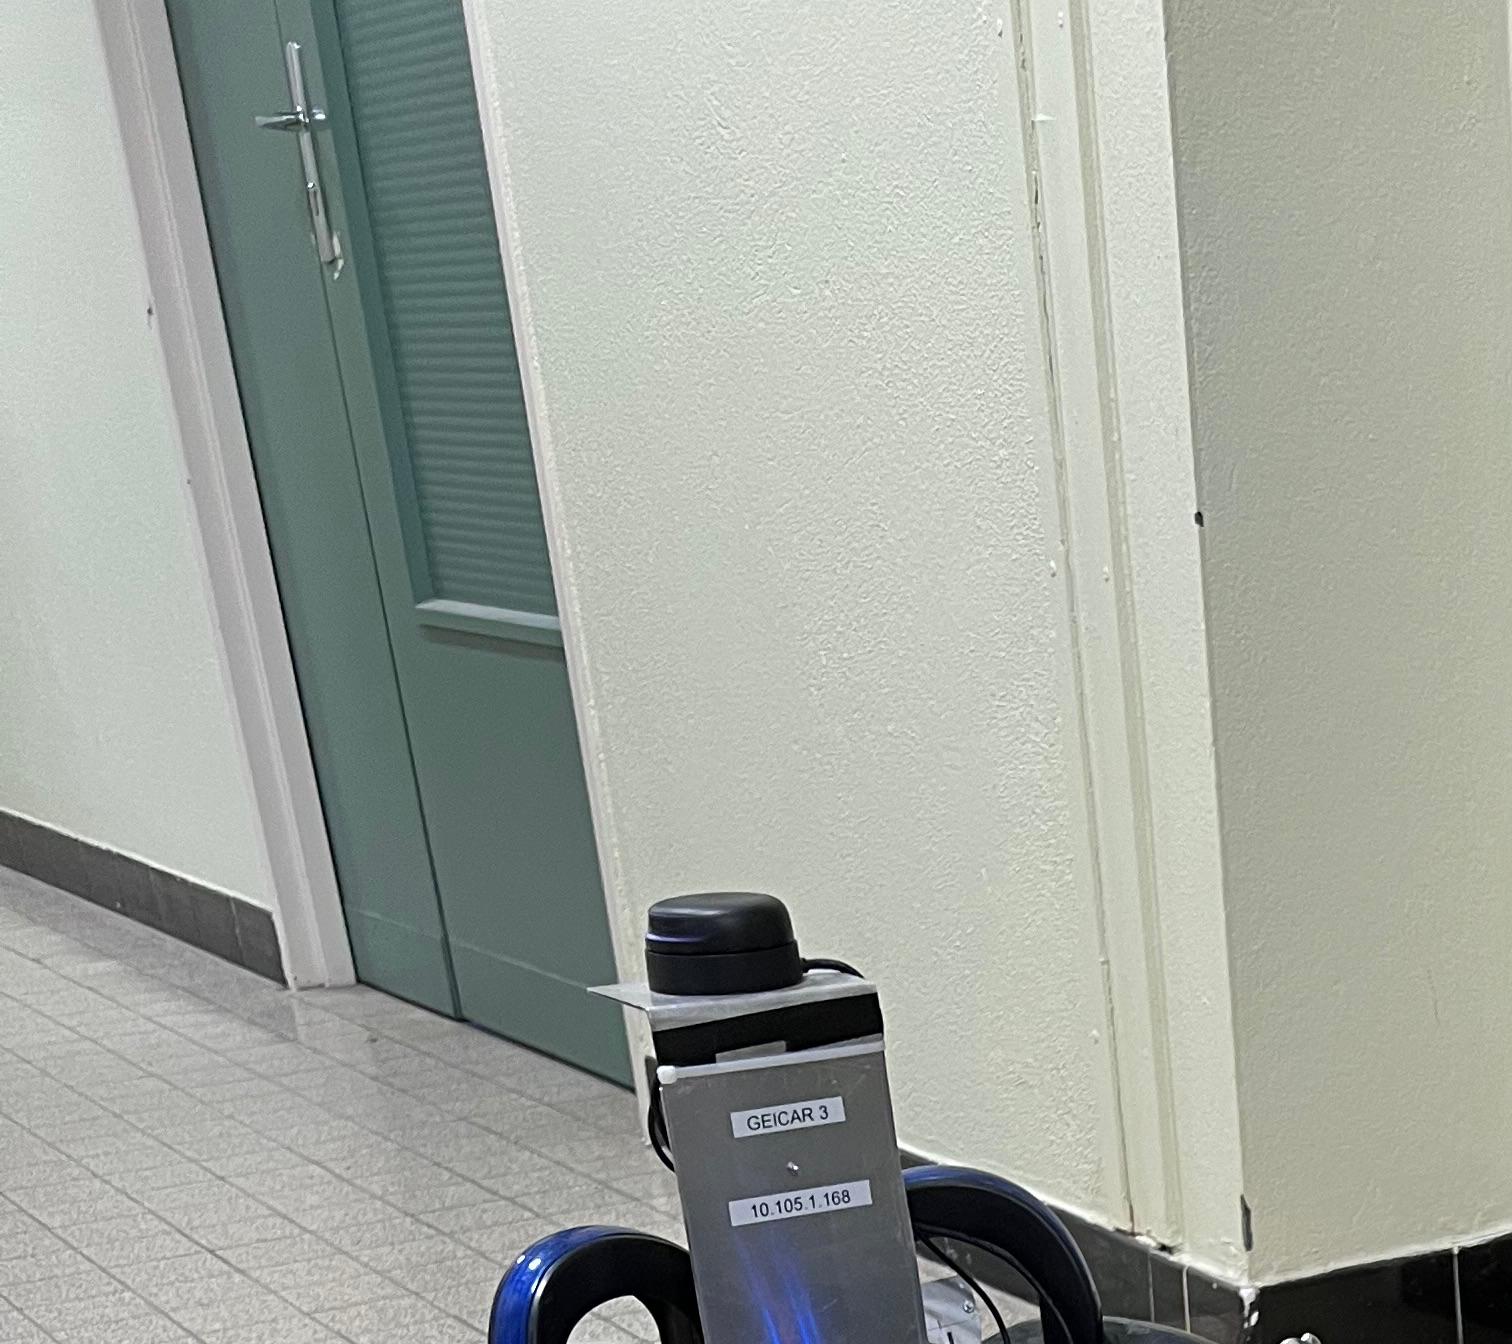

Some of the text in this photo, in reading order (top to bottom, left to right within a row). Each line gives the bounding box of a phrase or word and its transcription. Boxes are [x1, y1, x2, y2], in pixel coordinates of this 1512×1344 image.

[746, 1104, 829, 1131] GEICAR 3
[751, 1189, 851, 1218] 10.105.1.168
